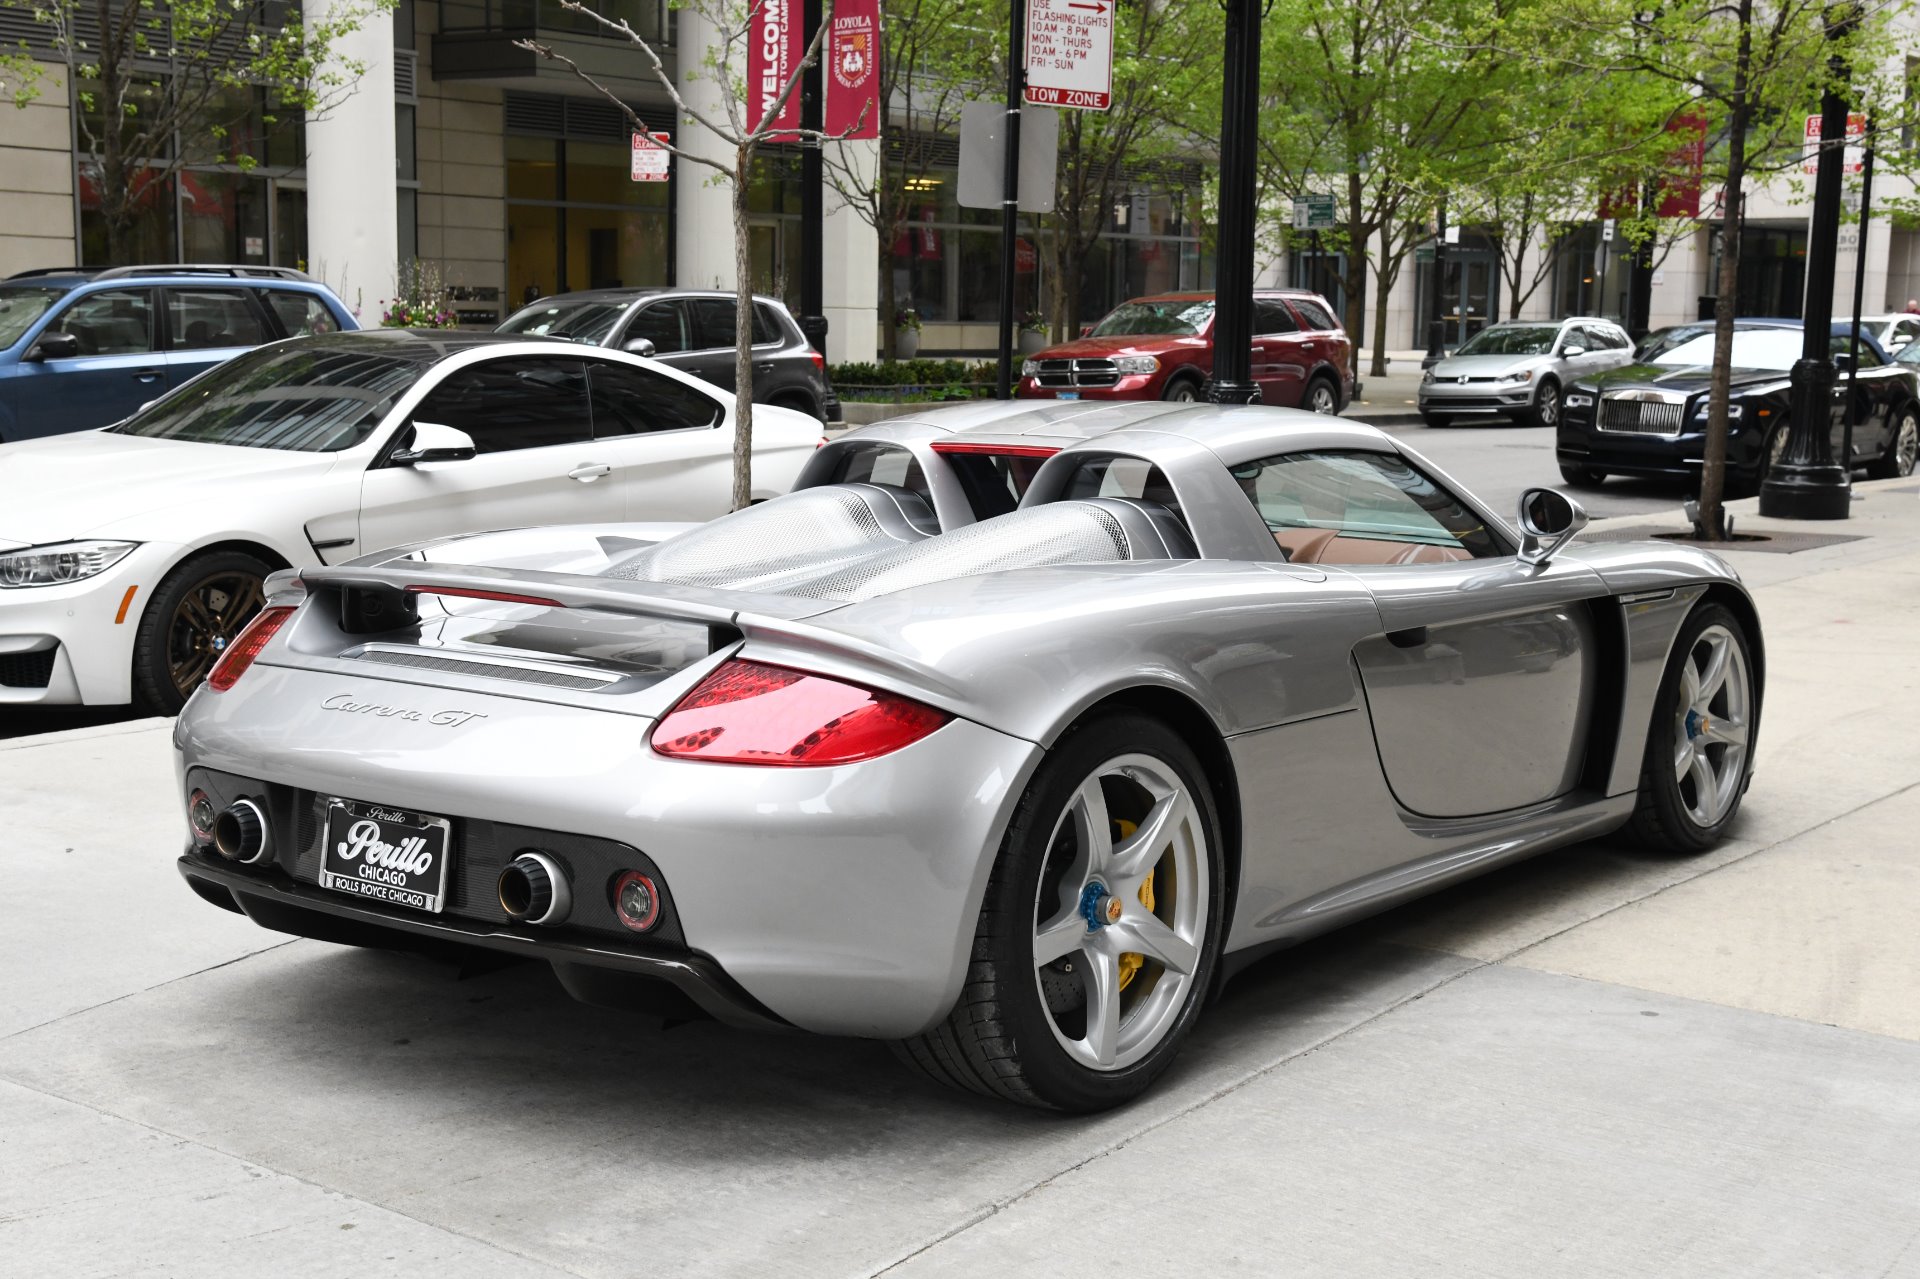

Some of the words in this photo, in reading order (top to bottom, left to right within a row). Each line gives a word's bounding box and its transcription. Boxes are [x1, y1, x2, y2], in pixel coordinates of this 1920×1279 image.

[1033, 0, 1051, 9] USE
[835, 15, 872, 30] LOYOLA
[1032, 10, 1076, 24] FLASHING
[1078, 16, 1108, 28] LIGHTS
[1031, 34, 1052, 44] MON
[1062, 36, 1092, 49] THURS
[780, 34, 788, 76] TOWER
[1031, 56, 1046, 67] FRI
[1055, 59, 1074, 70] SUN
[1030, 87, 1059, 102] TOW
[1066, 91, 1102, 107] ZONE
[321, 694, 422, 721] Carrera
[428, 709, 488, 727] GT
[366, 806, 406, 823] Perillo
[337, 820, 433, 876] Perillo
[358, 864, 407, 887] CHICAGO
[335, 877, 359, 893] ROLLS
[360, 883, 387, 899] ROYCE
[388, 890, 423, 907] CHICAGO
